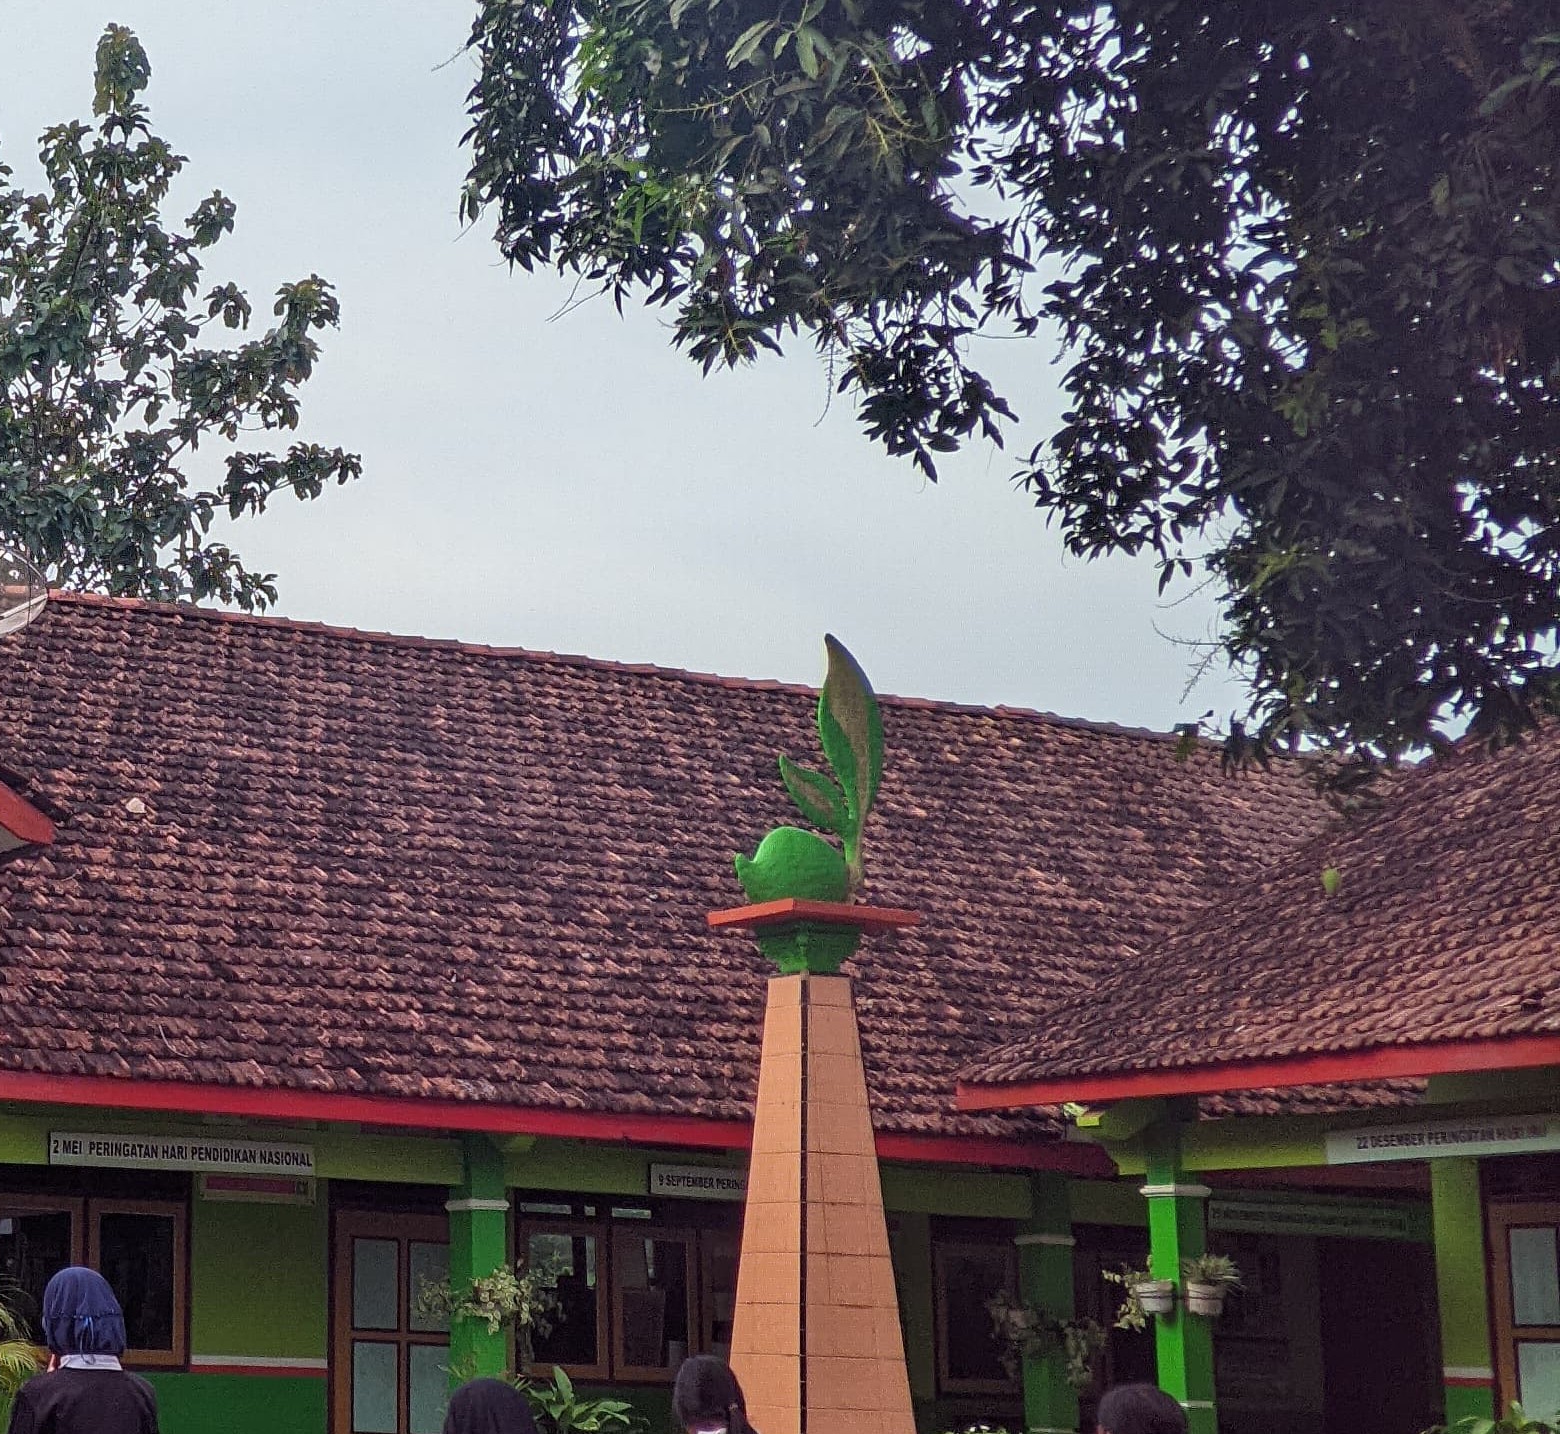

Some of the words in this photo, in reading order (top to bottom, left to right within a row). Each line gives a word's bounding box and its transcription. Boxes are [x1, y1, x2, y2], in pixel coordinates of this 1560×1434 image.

[1370, 1132, 1425, 1148] DESEMBER
[52, 1139, 59, 1154] 2
[62, 1140, 83, 1155] MEI
[89, 1141, 159, 1159] PERINGATAN
[161, 1143, 188, 1160] HARI
[190, 1145, 258, 1164] PENDIDIKAN
[259, 1149, 313, 1168] NASIONAL
[665, 1174, 715, 1189] SEPTEMBER
